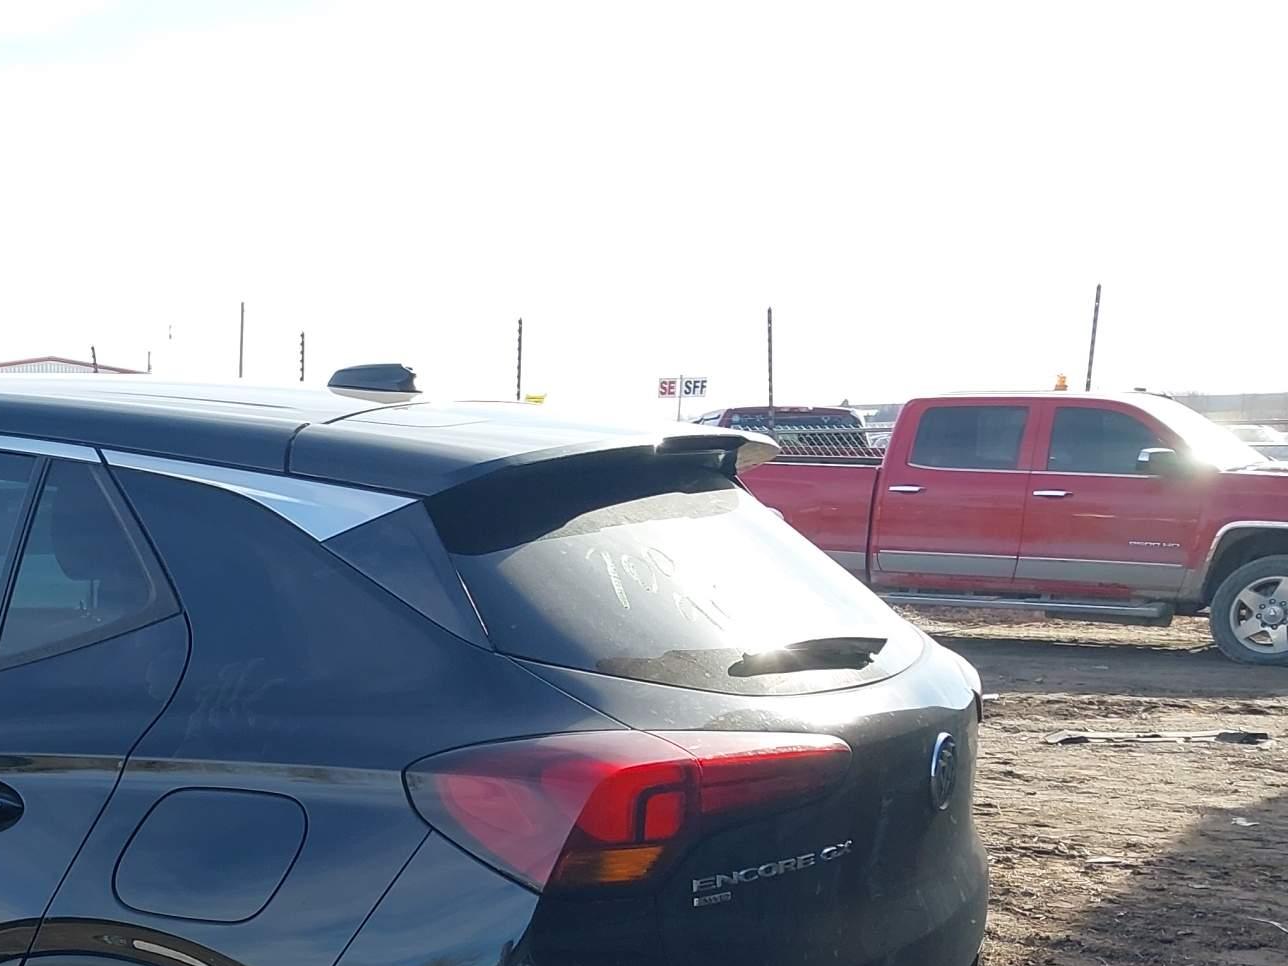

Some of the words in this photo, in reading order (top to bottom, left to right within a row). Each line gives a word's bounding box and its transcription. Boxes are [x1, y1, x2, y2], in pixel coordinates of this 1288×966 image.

[659, 381, 676, 395] SE
[684, 380, 707, 395] SFF
[692, 853, 816, 892] ENCORE
[819, 840, 853, 860] GX
